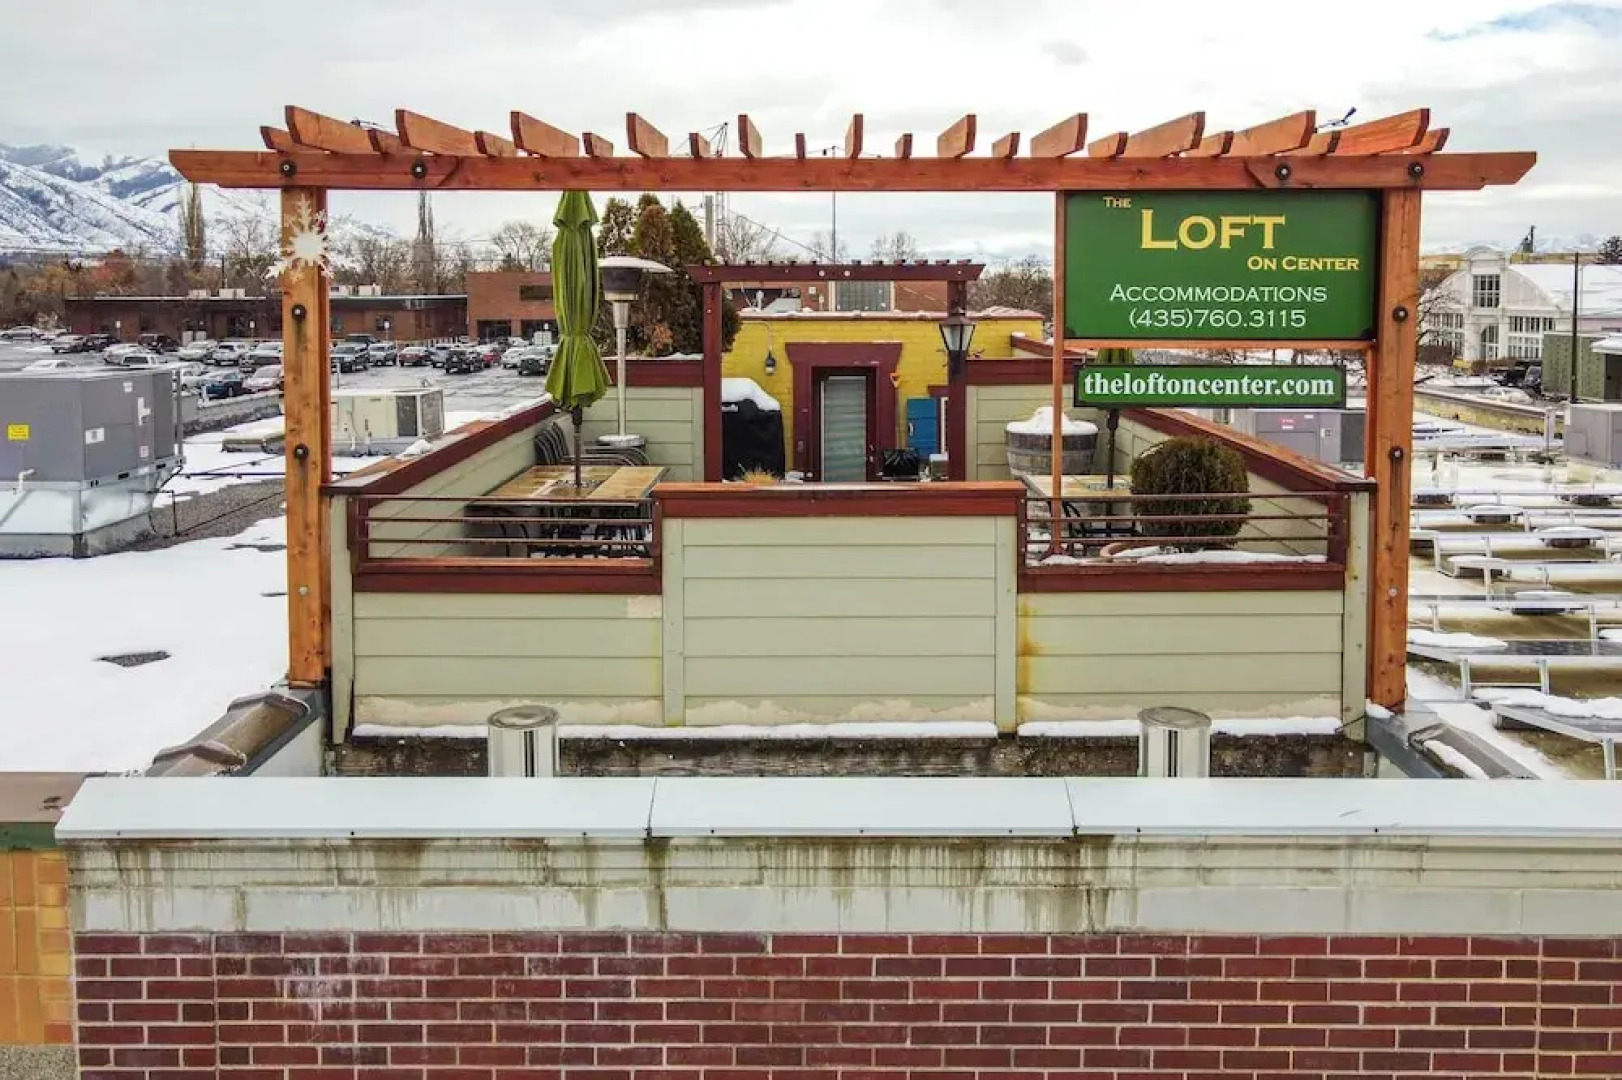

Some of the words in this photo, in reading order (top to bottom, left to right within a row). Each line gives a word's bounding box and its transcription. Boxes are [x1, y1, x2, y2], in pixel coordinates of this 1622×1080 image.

[1247, 256, 1277, 271] ON
[1282, 256, 1360, 272] CENTER
[1109, 284, 1328, 302] ACCOMMODATIONS
[1129, 308, 1307, 329] (435)760.3115
[1084, 373, 1335, 395] theloftoncenter.com
